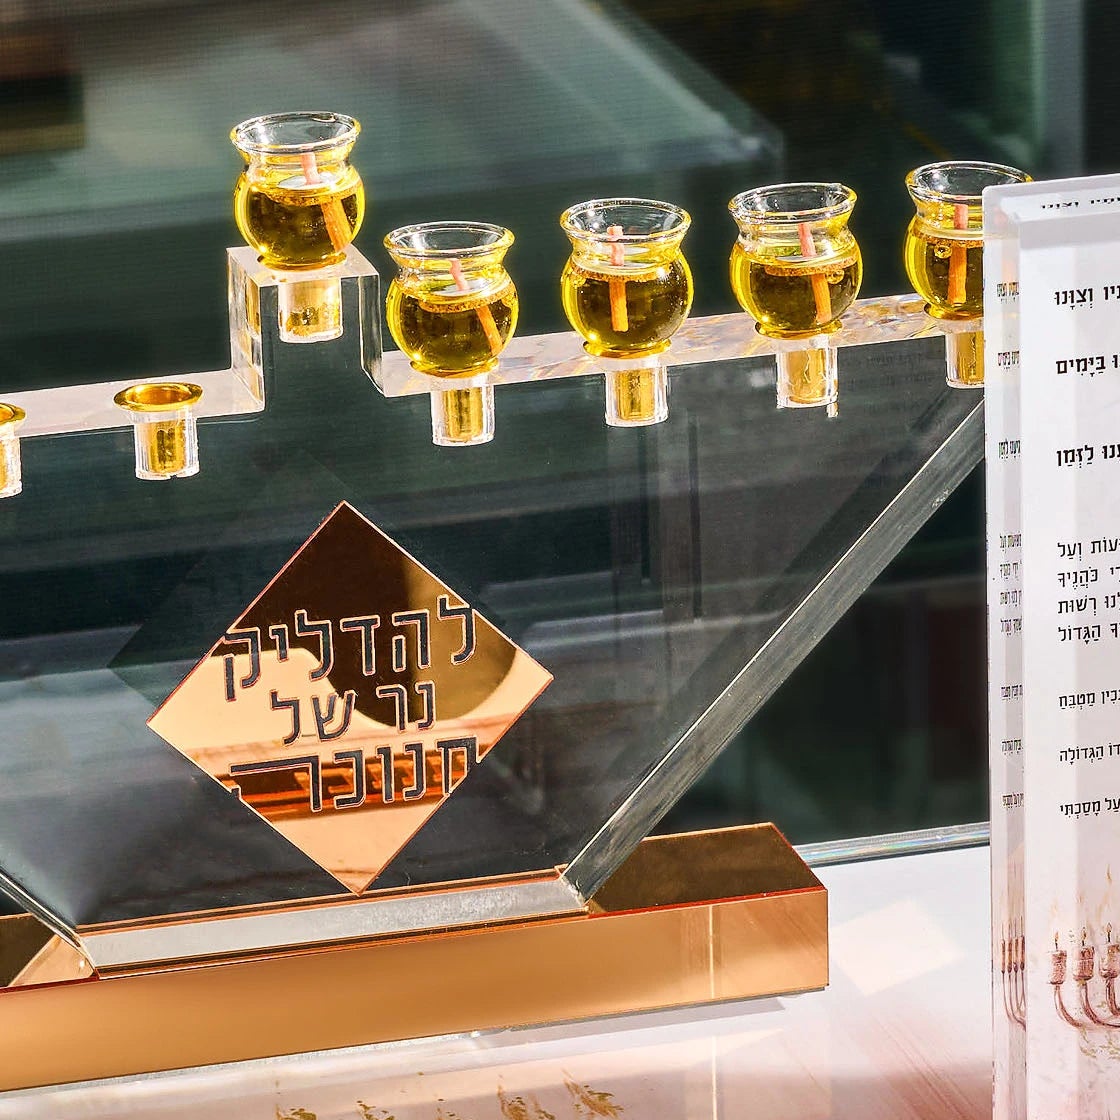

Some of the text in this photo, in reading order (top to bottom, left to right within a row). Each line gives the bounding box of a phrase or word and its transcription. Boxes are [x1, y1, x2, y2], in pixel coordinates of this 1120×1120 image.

[223, 594, 476, 702] להדליק
[270, 680, 435, 747] נר של
[230, 734, 480, 812] חנוכה
